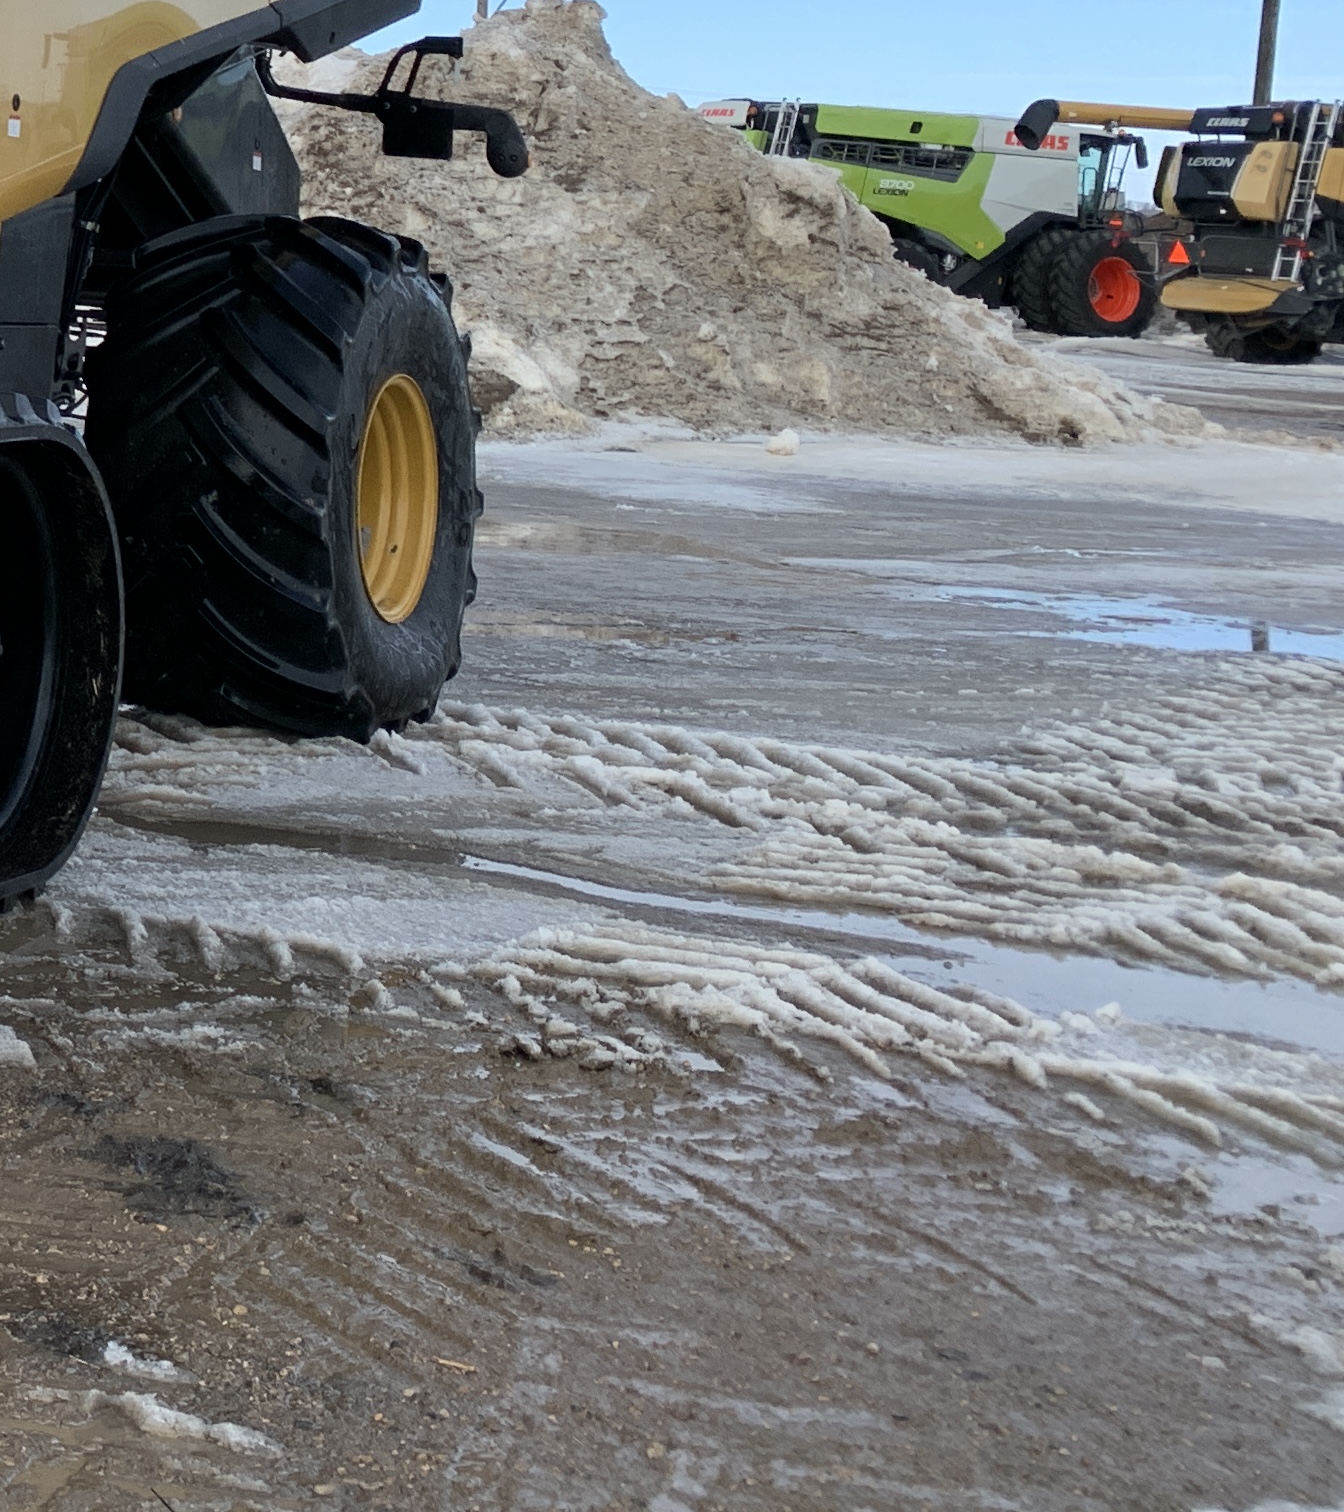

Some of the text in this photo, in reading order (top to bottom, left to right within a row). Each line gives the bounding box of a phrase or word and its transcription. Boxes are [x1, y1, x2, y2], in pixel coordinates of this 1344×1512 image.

[1206, 117, 1250, 127] CLAAS
[1005, 131, 1070, 151] CAS
[1187, 156, 1236, 168] LEXION
[880, 179, 915, 190] 8700
[873, 187, 910, 197] LEXION
